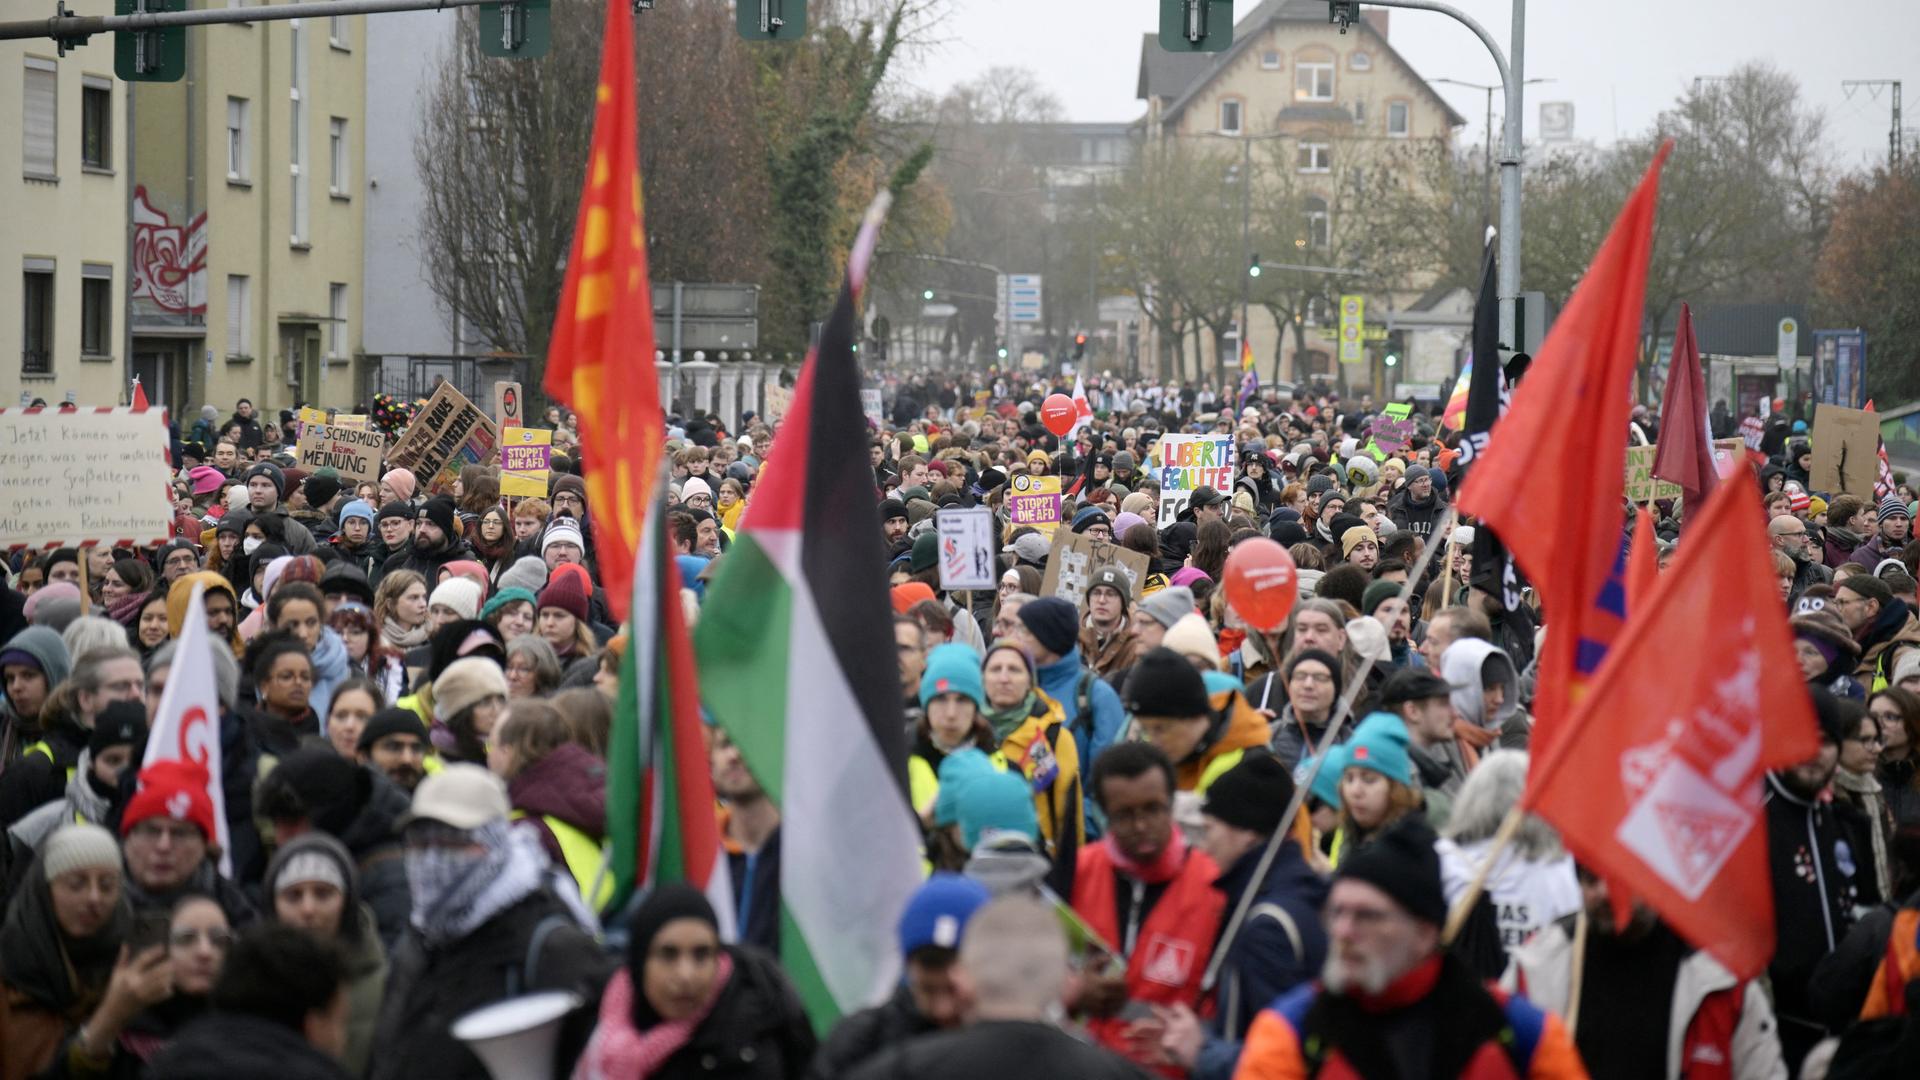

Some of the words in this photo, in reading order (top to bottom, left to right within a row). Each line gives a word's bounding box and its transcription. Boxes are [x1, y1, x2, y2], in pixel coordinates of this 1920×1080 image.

[6, 425, 47, 444] Jetzt
[116, 431, 140, 441] wir
[315, 441, 325, 451] ist
[507, 447, 544, 459] STOPPT
[1164, 435, 1234, 467] LIBERTÉ
[51, 452, 76, 463] was
[86, 452, 109, 462] wir
[303, 450, 367, 474] MEINUNG
[508, 458, 524, 469] DIE
[526, 457, 545, 469] AFD
[415, 453, 442, 487] AUS
[1162, 464, 1231, 490] ÉGALITÉ
[1, 475, 51, 487] unserer
[63, 469, 141, 490] Großeltern
[12, 495, 52, 513] getan
[1017, 496, 1054, 510] STOPPT
[1018, 510, 1036, 521] DIE
[1036, 508, 1055, 520] AFD
